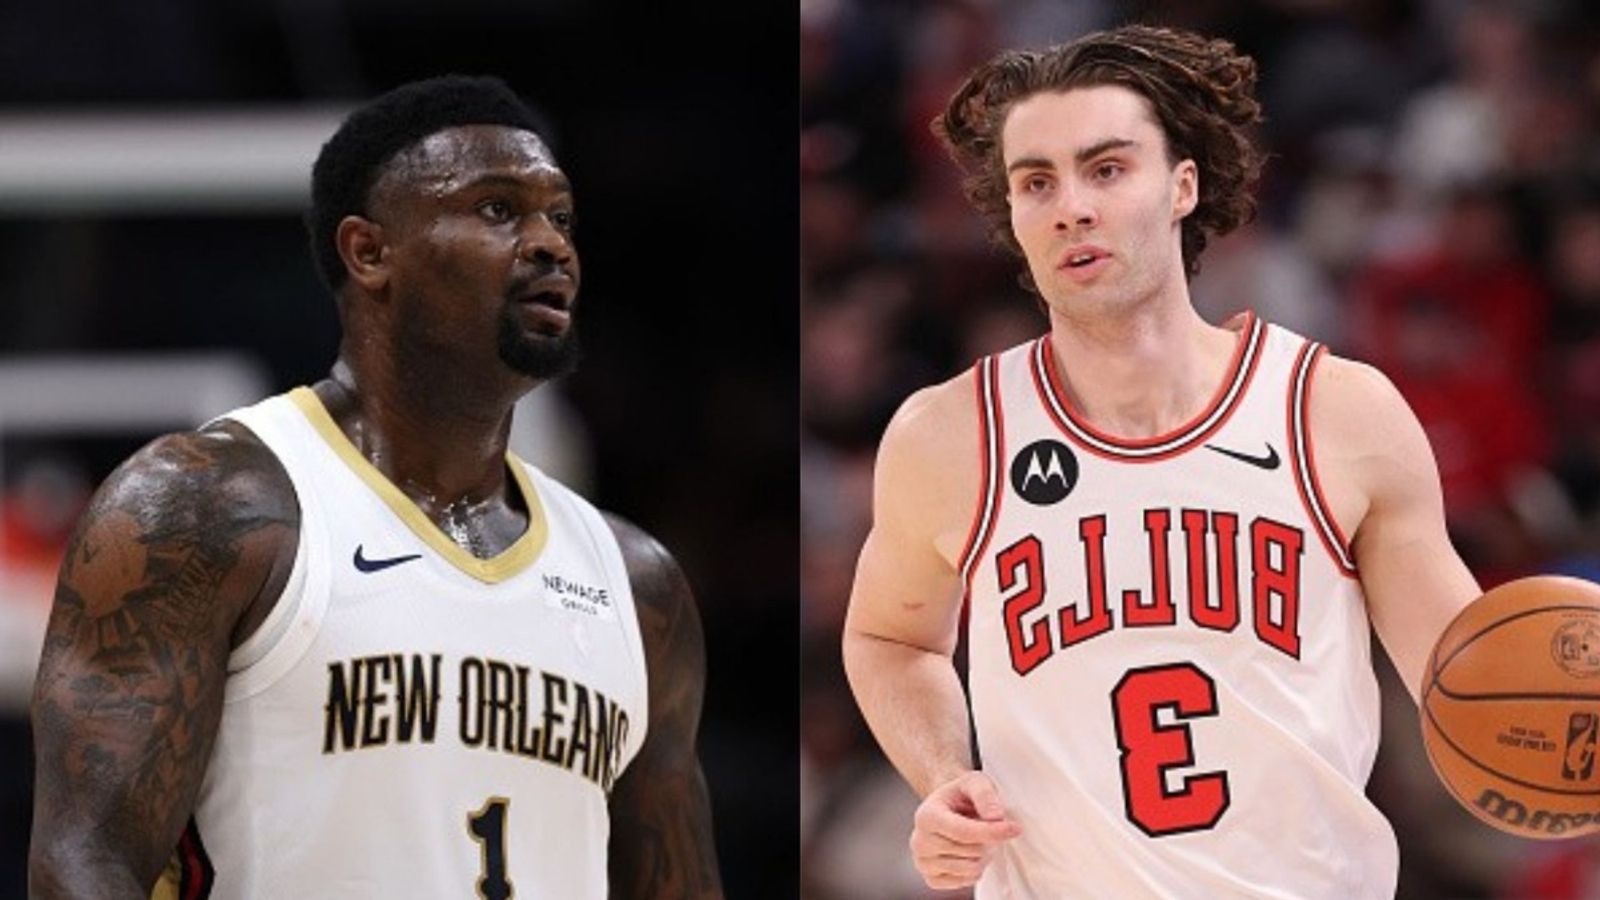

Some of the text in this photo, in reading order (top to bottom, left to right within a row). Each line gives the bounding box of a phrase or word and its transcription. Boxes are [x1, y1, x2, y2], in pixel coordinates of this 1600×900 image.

[542, 573, 609, 606] NEWAGE
[322, 653, 629, 793] NEW ORLEANS
[466, 796, 514, 900] 1
